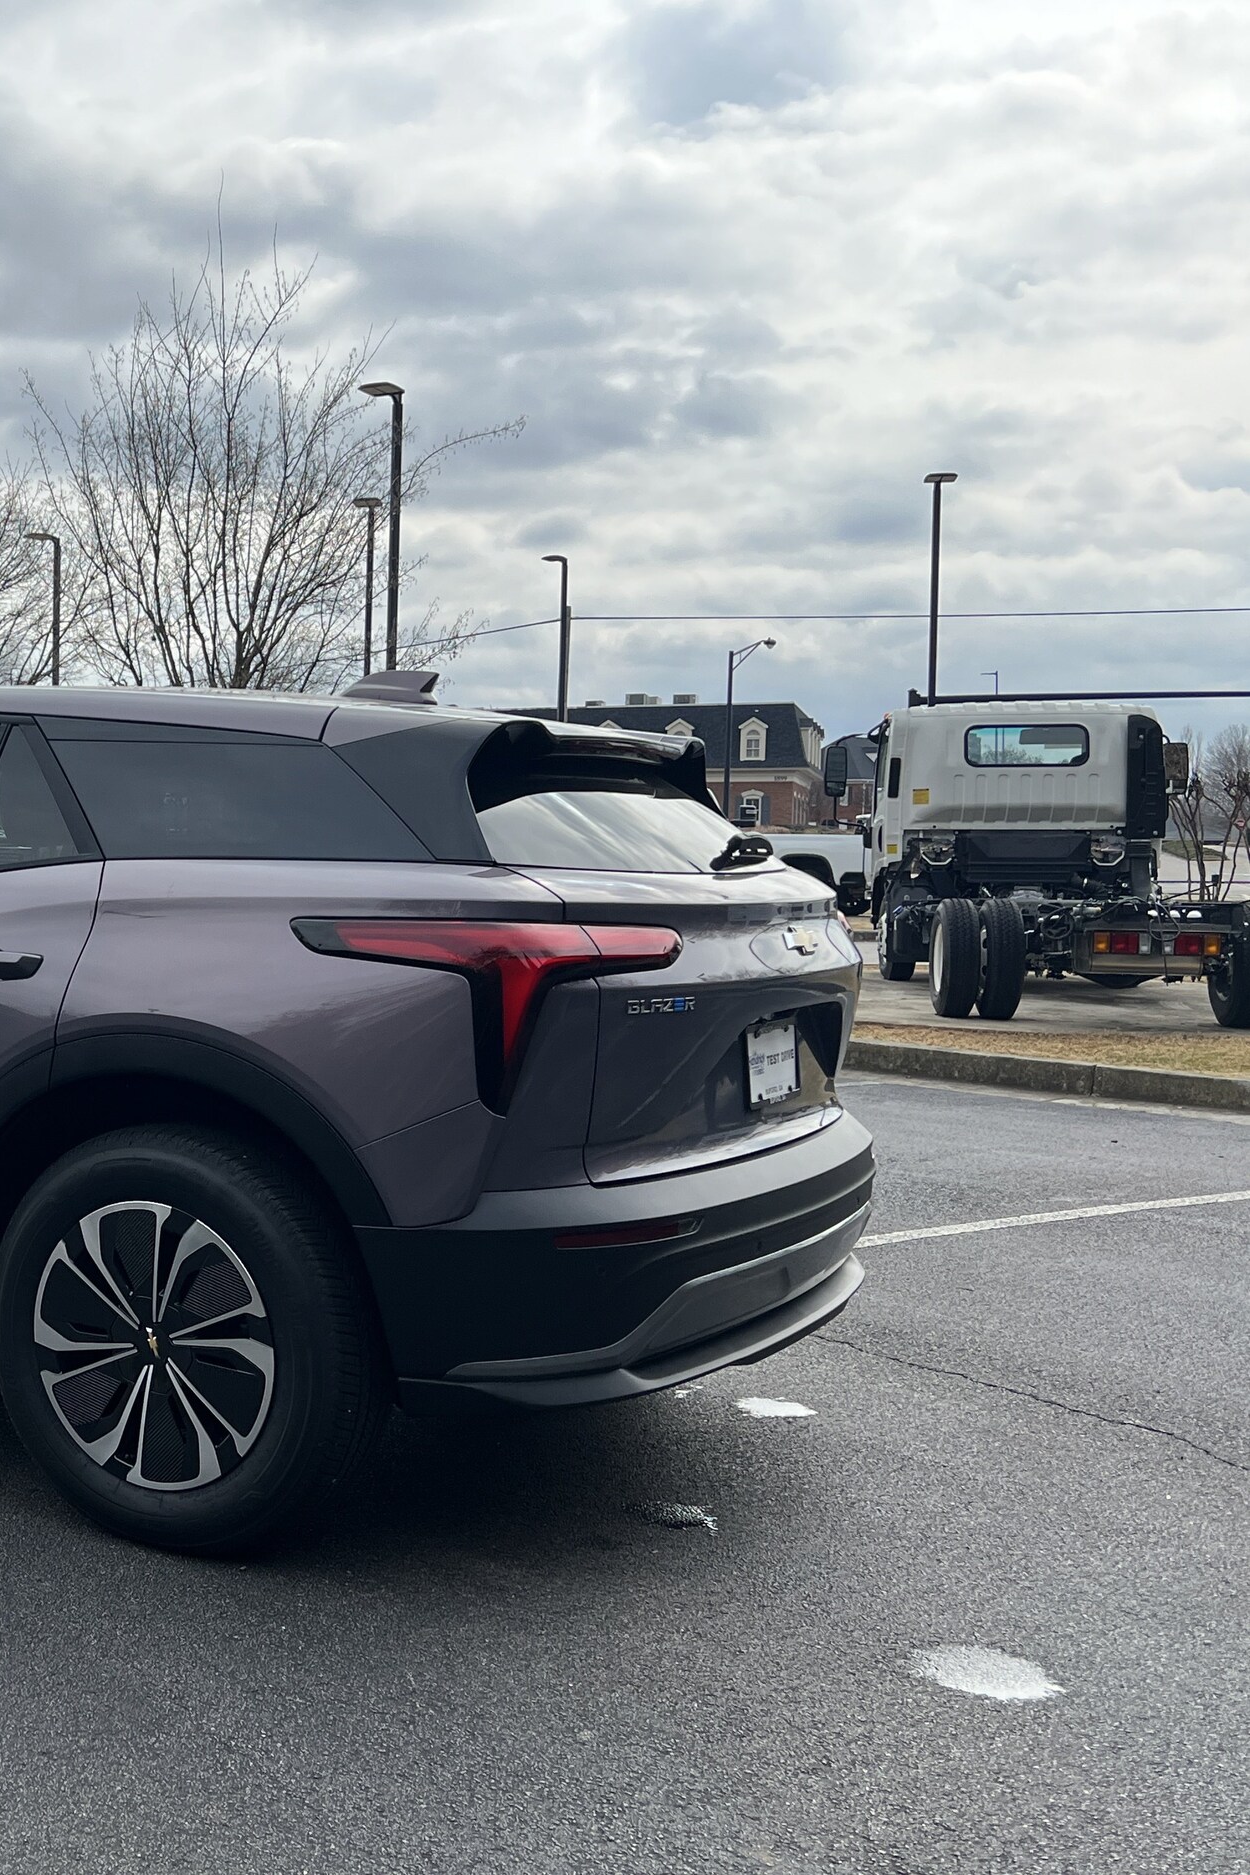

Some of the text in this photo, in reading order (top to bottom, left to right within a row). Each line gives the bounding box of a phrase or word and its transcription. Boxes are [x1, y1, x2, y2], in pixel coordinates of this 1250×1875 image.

[627, 996, 696, 1014] BLAZER
[766, 1049, 794, 1066] TEST DRIVE
